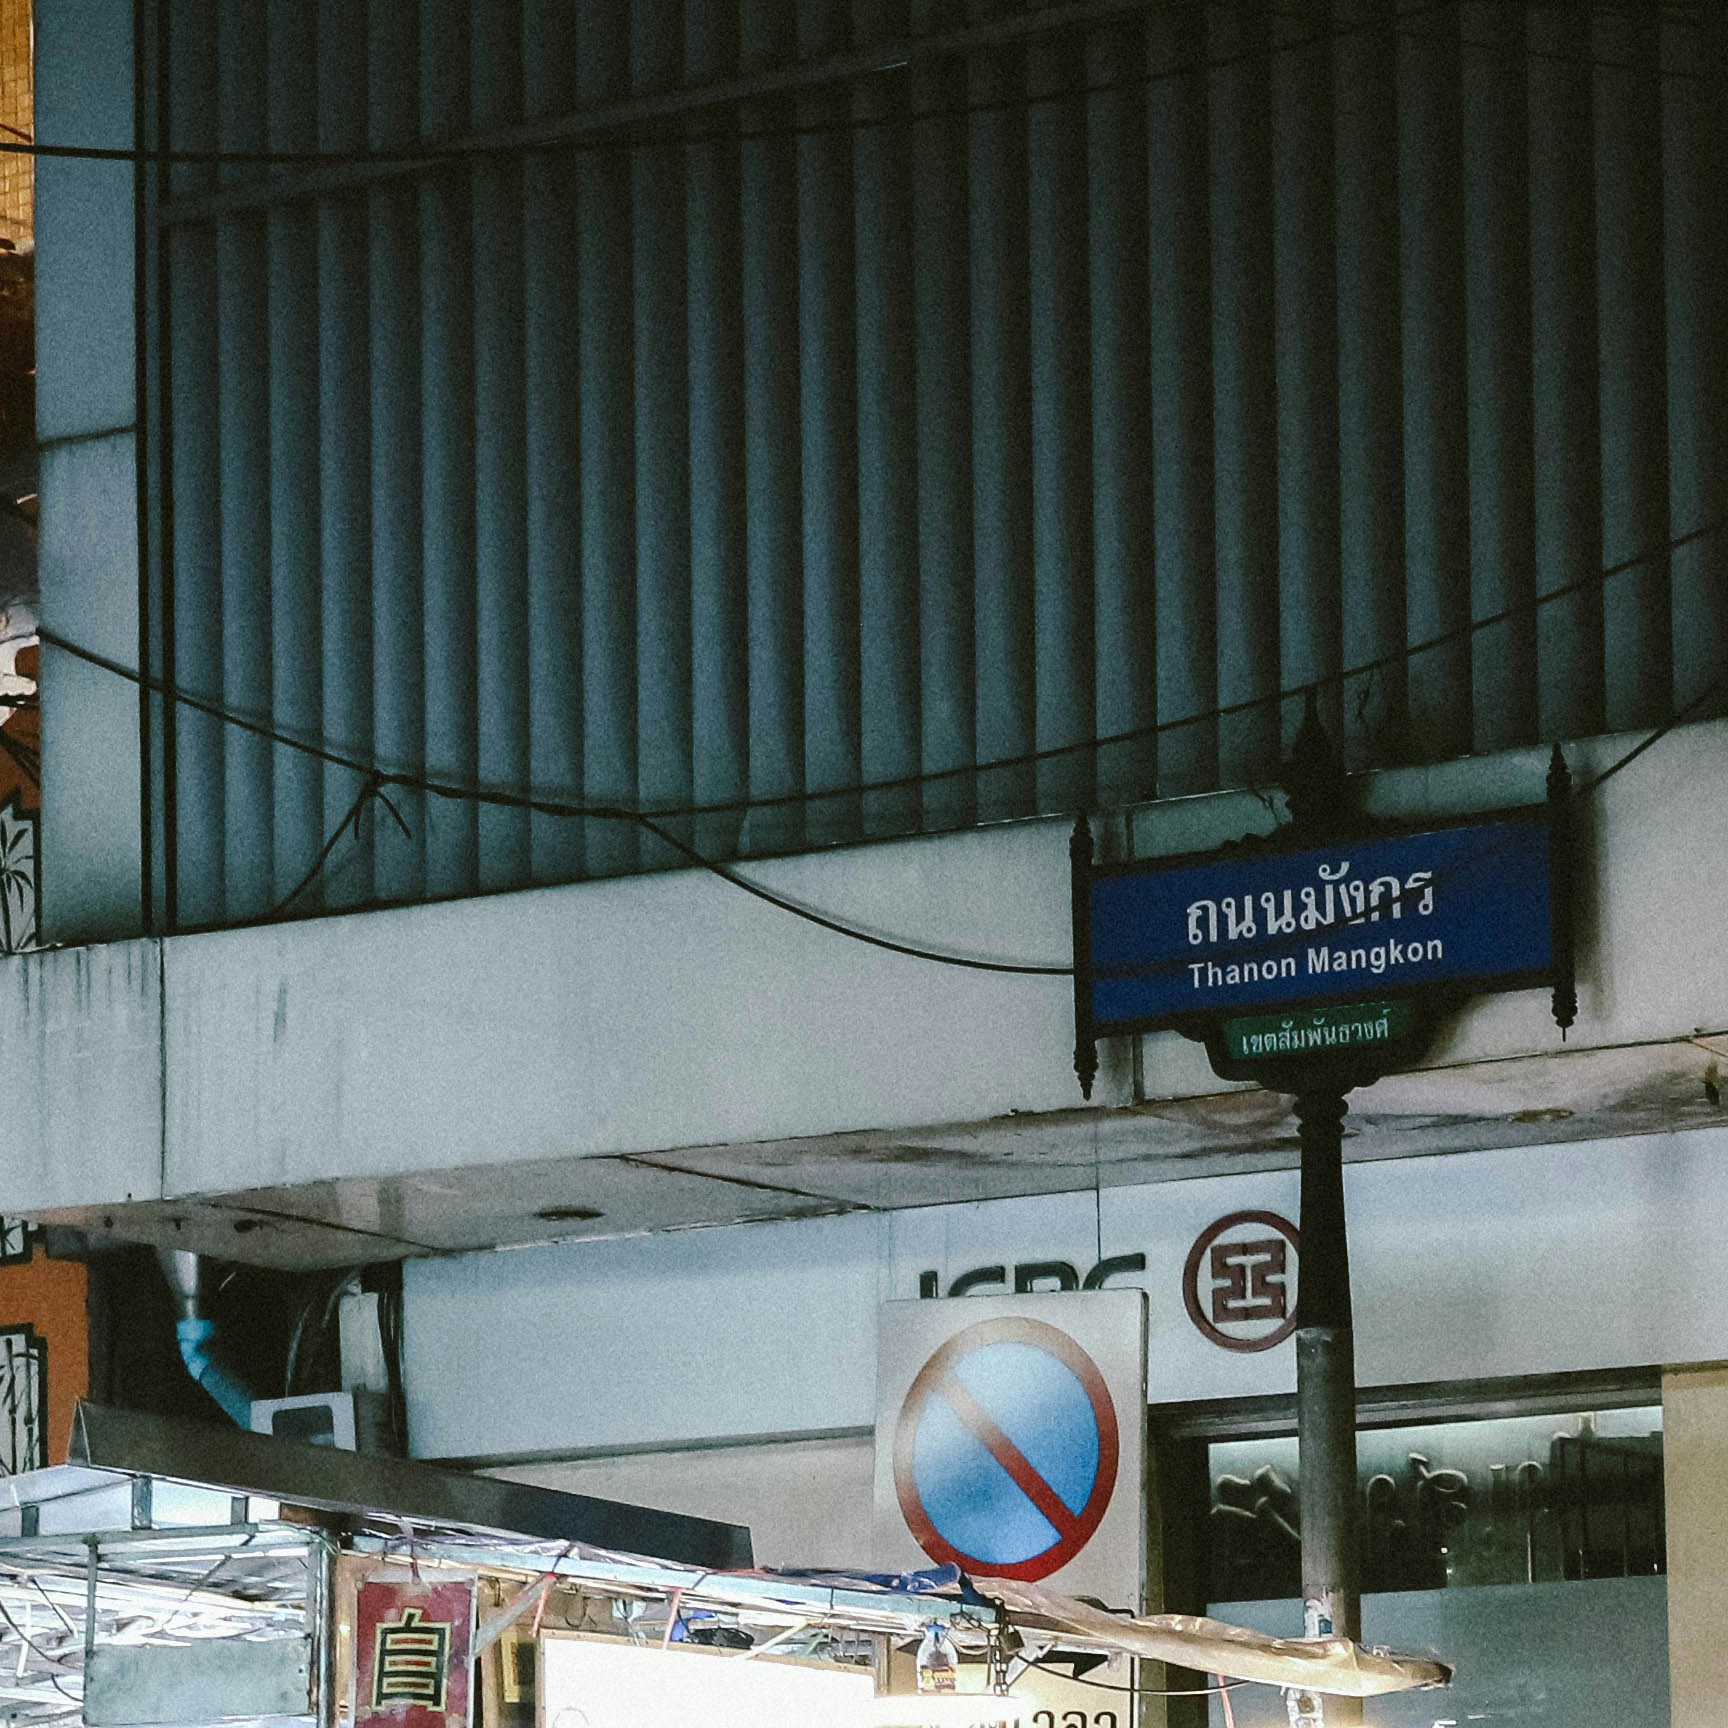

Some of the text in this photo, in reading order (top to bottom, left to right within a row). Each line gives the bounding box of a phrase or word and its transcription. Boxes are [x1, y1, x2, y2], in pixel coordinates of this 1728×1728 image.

[1186, 860, 1434, 946] ถนนมังกร
[1189, 939, 1444, 989] Thanon Mangkon
[1241, 1010, 1389, 1055] เขตสัมพันธวงศ์
